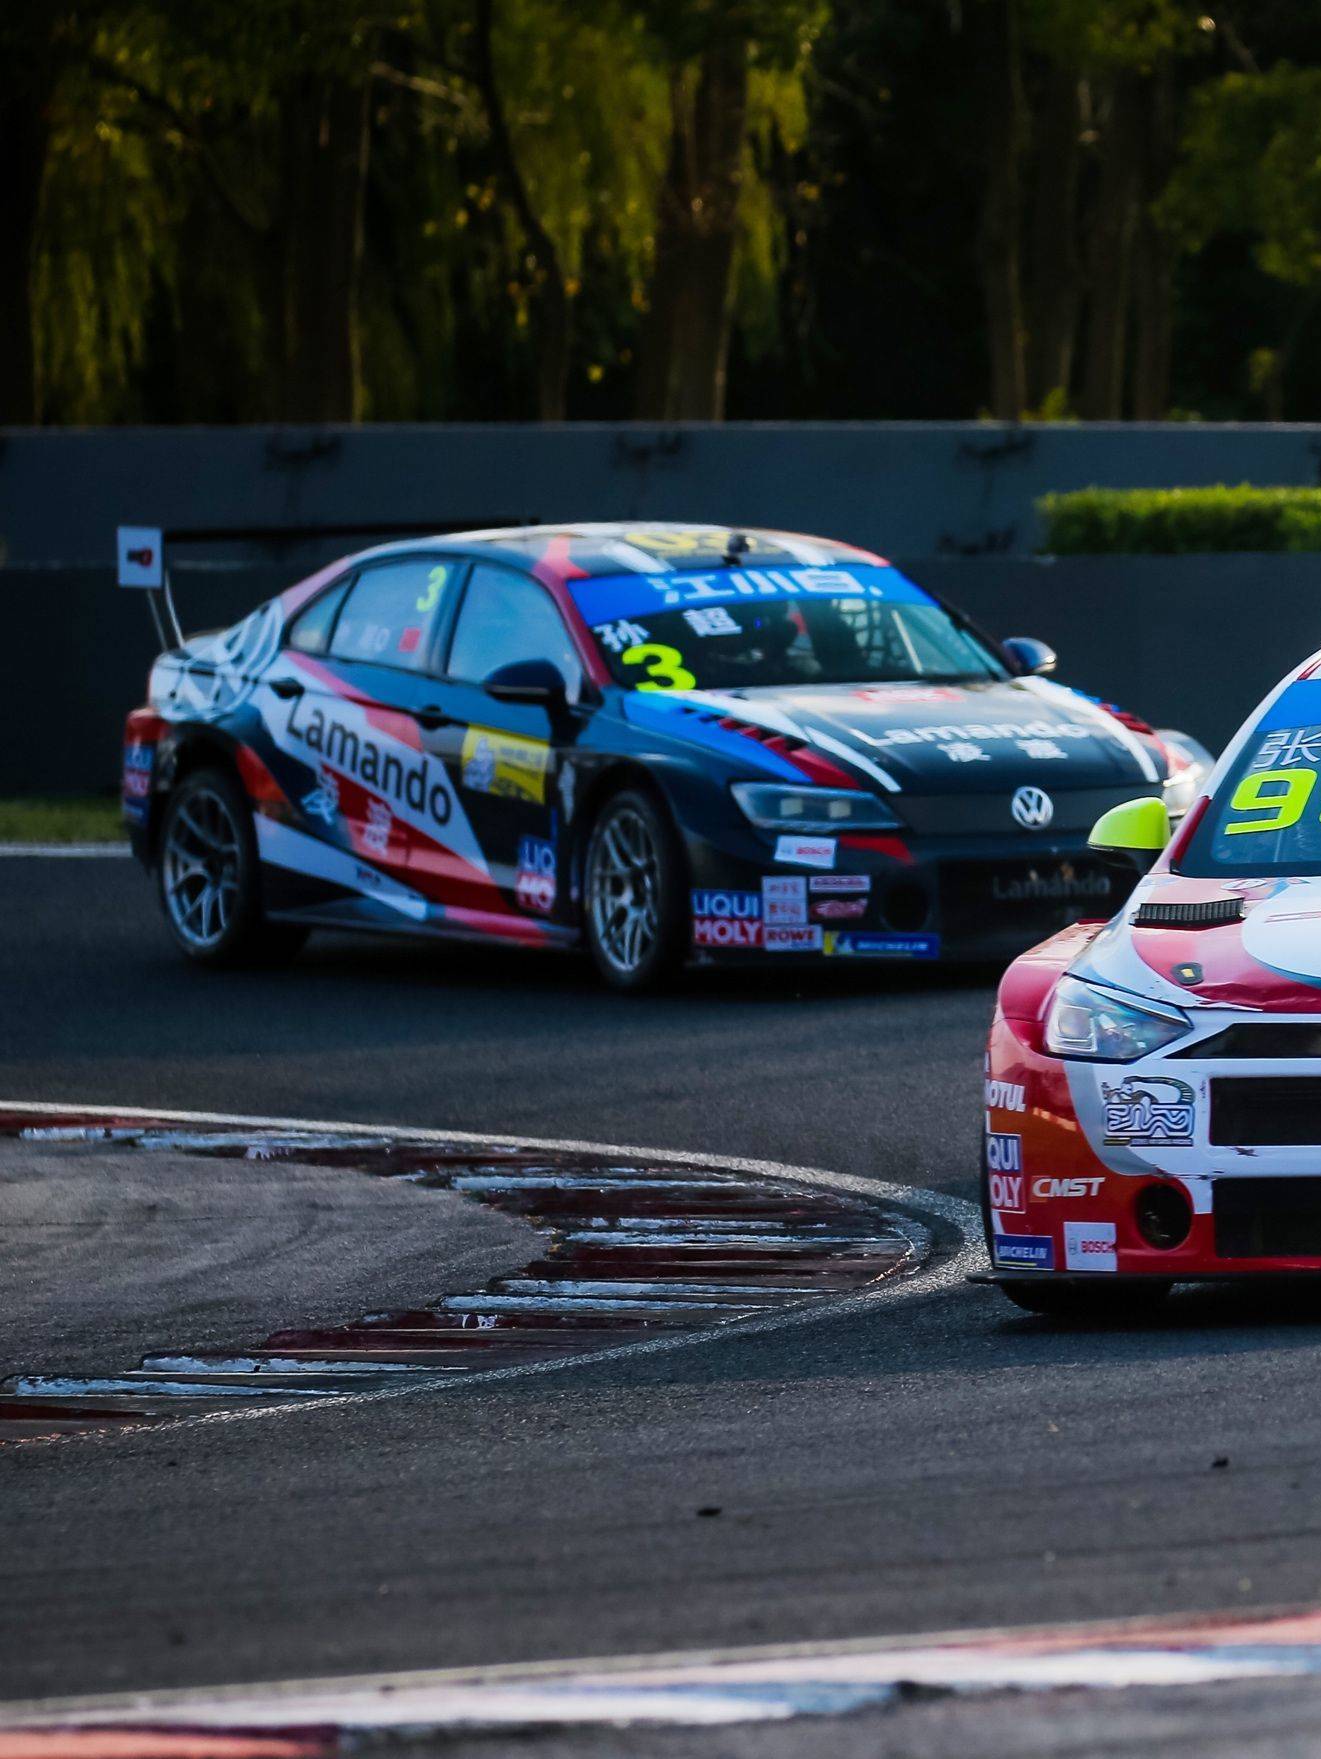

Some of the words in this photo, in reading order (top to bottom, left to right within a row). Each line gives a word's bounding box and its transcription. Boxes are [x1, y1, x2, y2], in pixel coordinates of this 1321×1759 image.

[416, 565, 447, 612] 3
[621, 643, 696, 692] 3
[286, 692, 452, 826] Lamando
[692, 893, 760, 918] LIQUI
[693, 920, 762, 944] MOLY
[987, 1137, 1019, 1171] QUI
[990, 1175, 1022, 1208] OLY
[1032, 1177, 1105, 1197] CMST
